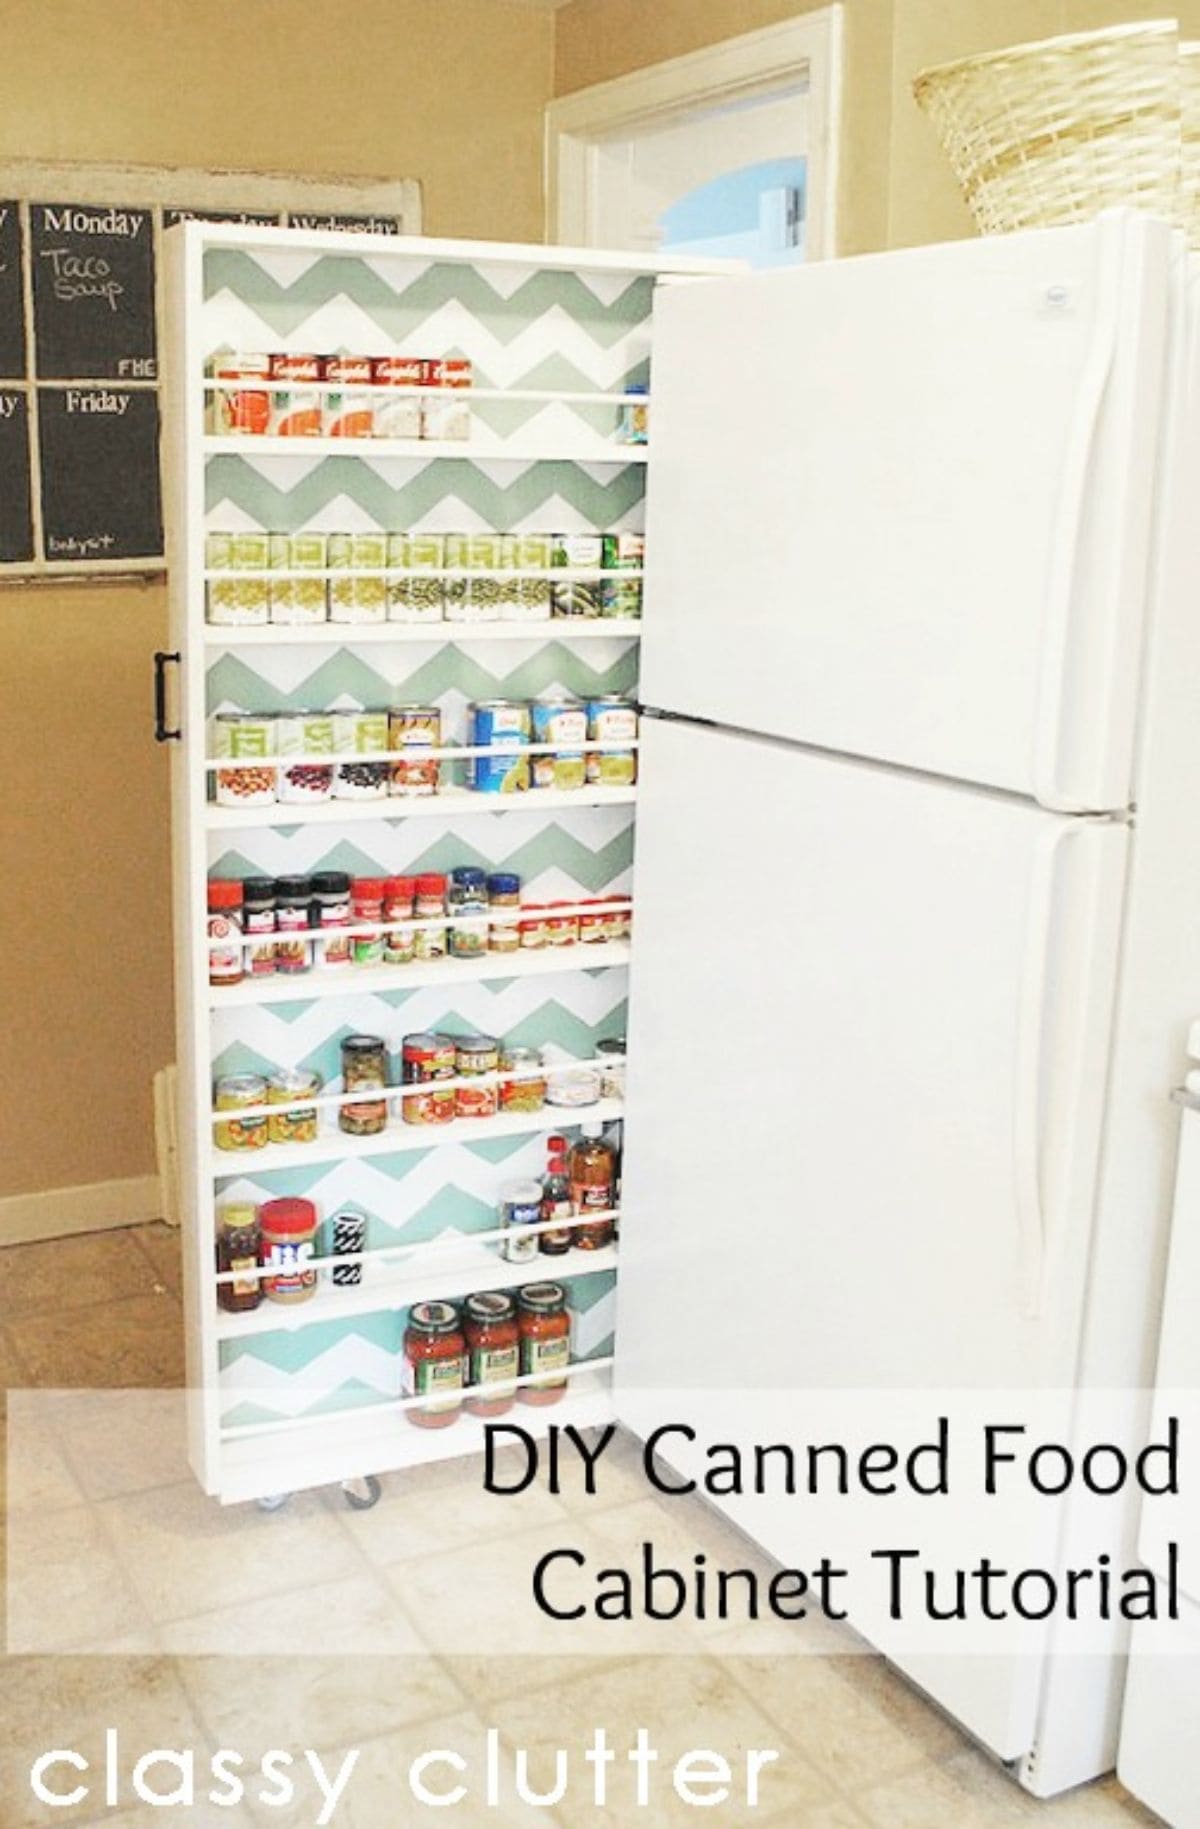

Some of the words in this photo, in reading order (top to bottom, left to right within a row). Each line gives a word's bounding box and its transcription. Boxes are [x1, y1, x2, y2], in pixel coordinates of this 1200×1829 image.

[44, 208, 144, 239] Monday
[40, 249, 111, 279] Taco
[66, 389, 130, 415] Friday
